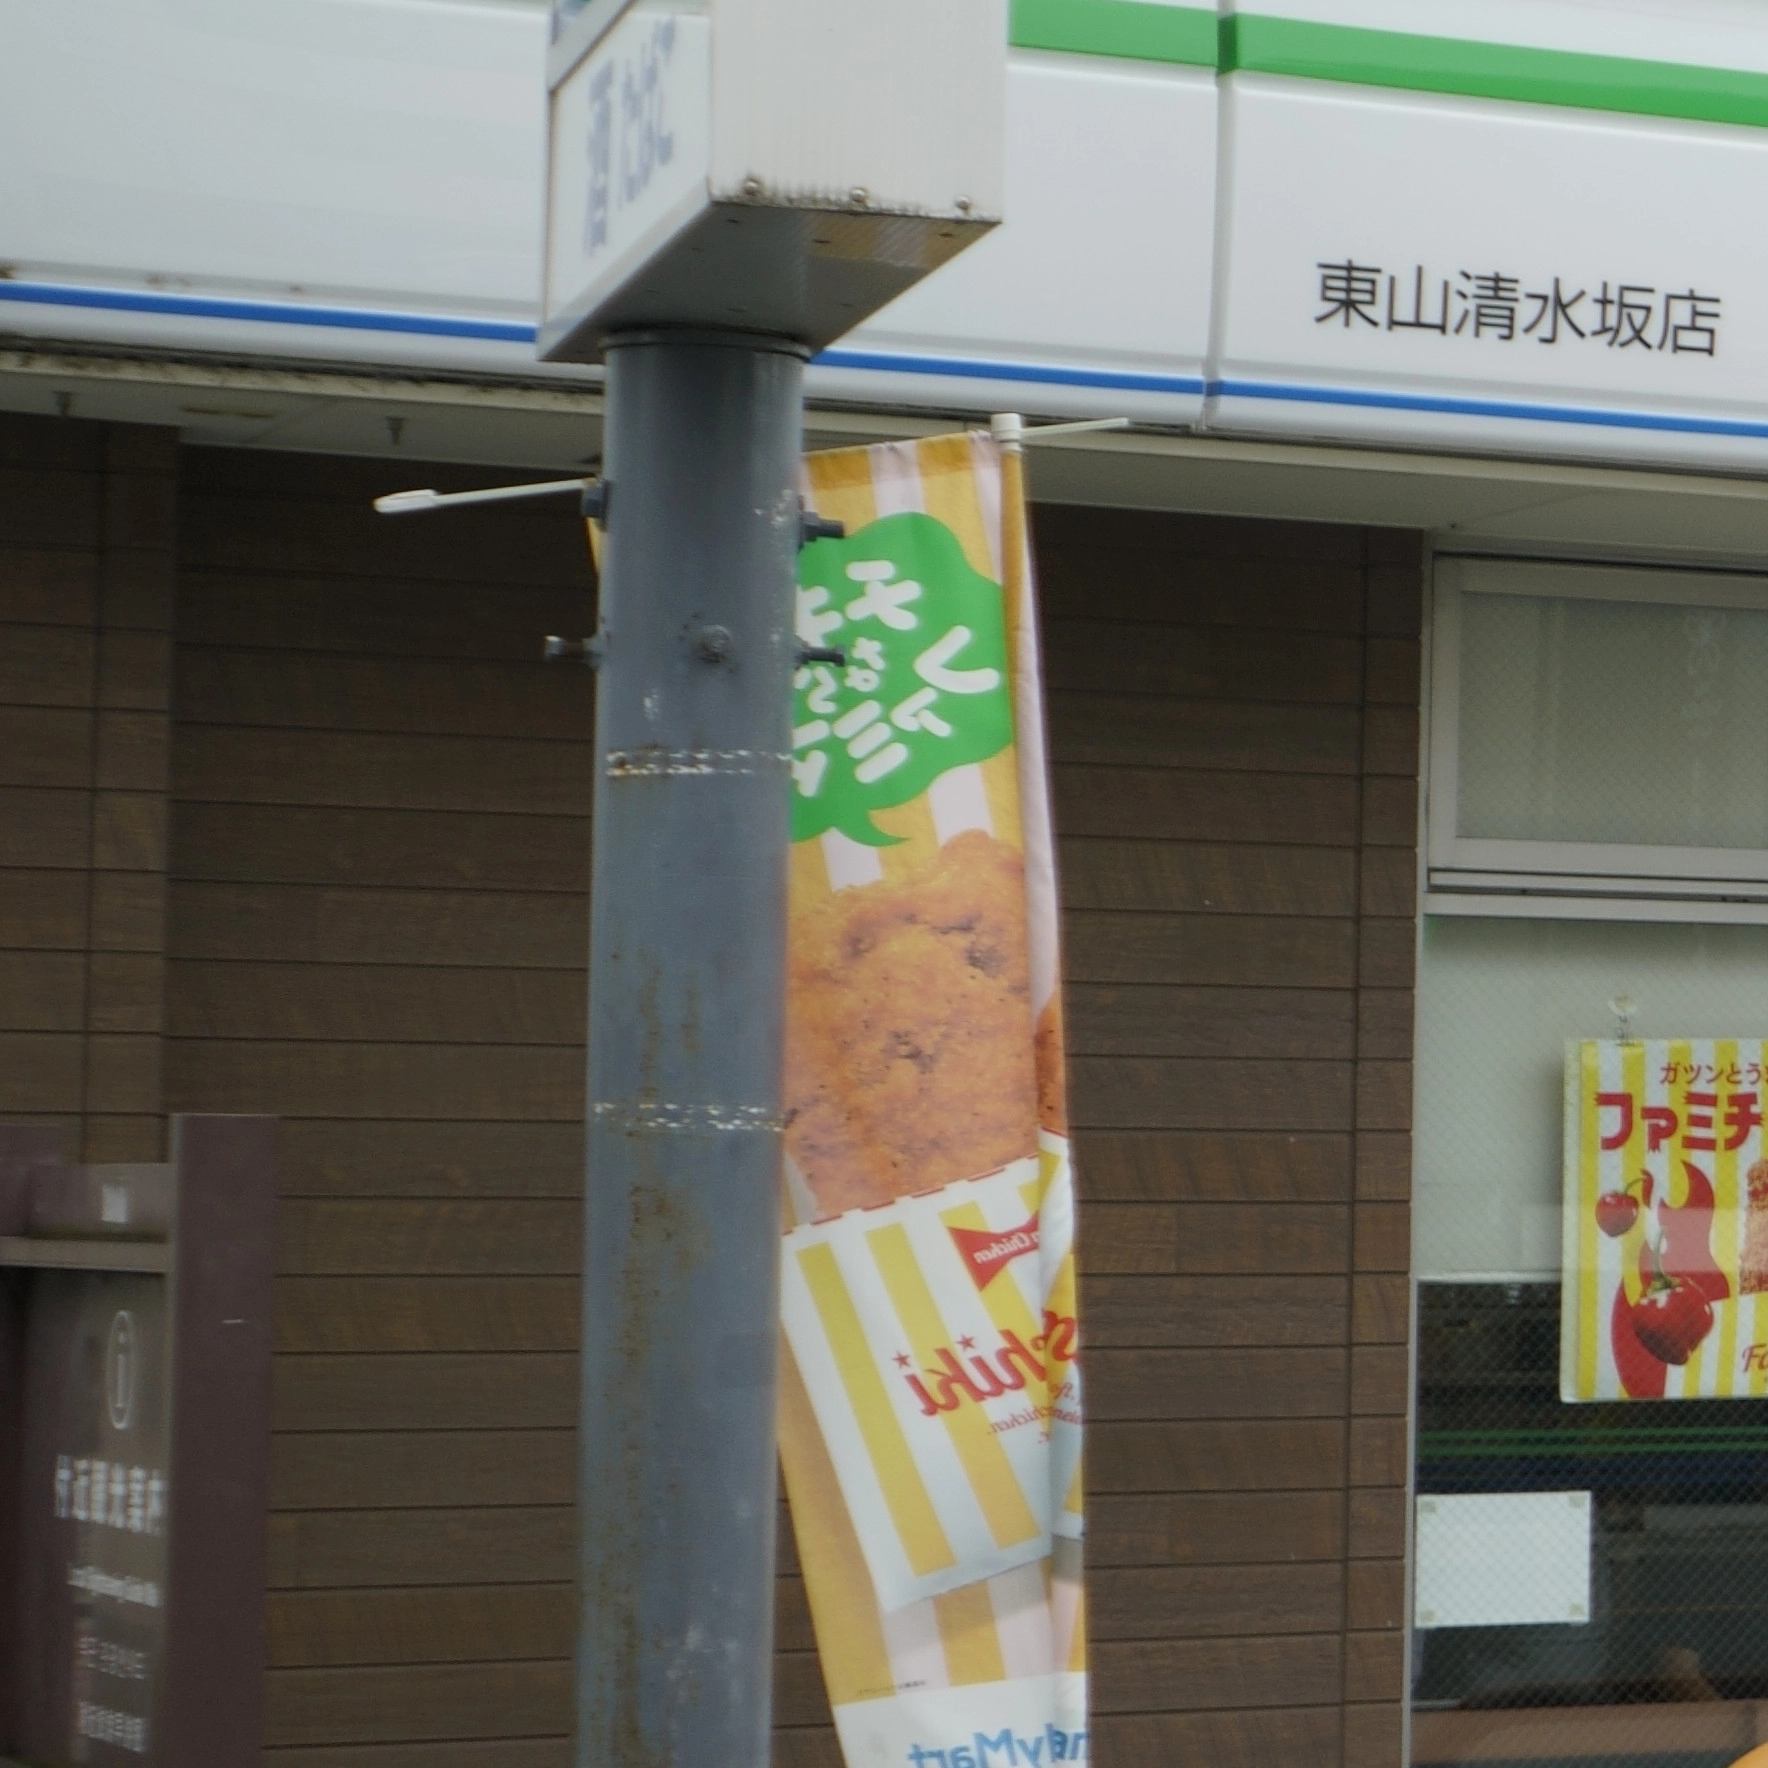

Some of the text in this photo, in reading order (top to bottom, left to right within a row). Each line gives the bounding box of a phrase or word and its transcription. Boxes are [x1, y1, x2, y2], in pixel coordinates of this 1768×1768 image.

[1313, 258, 1723, 358] 東山清水坂店
